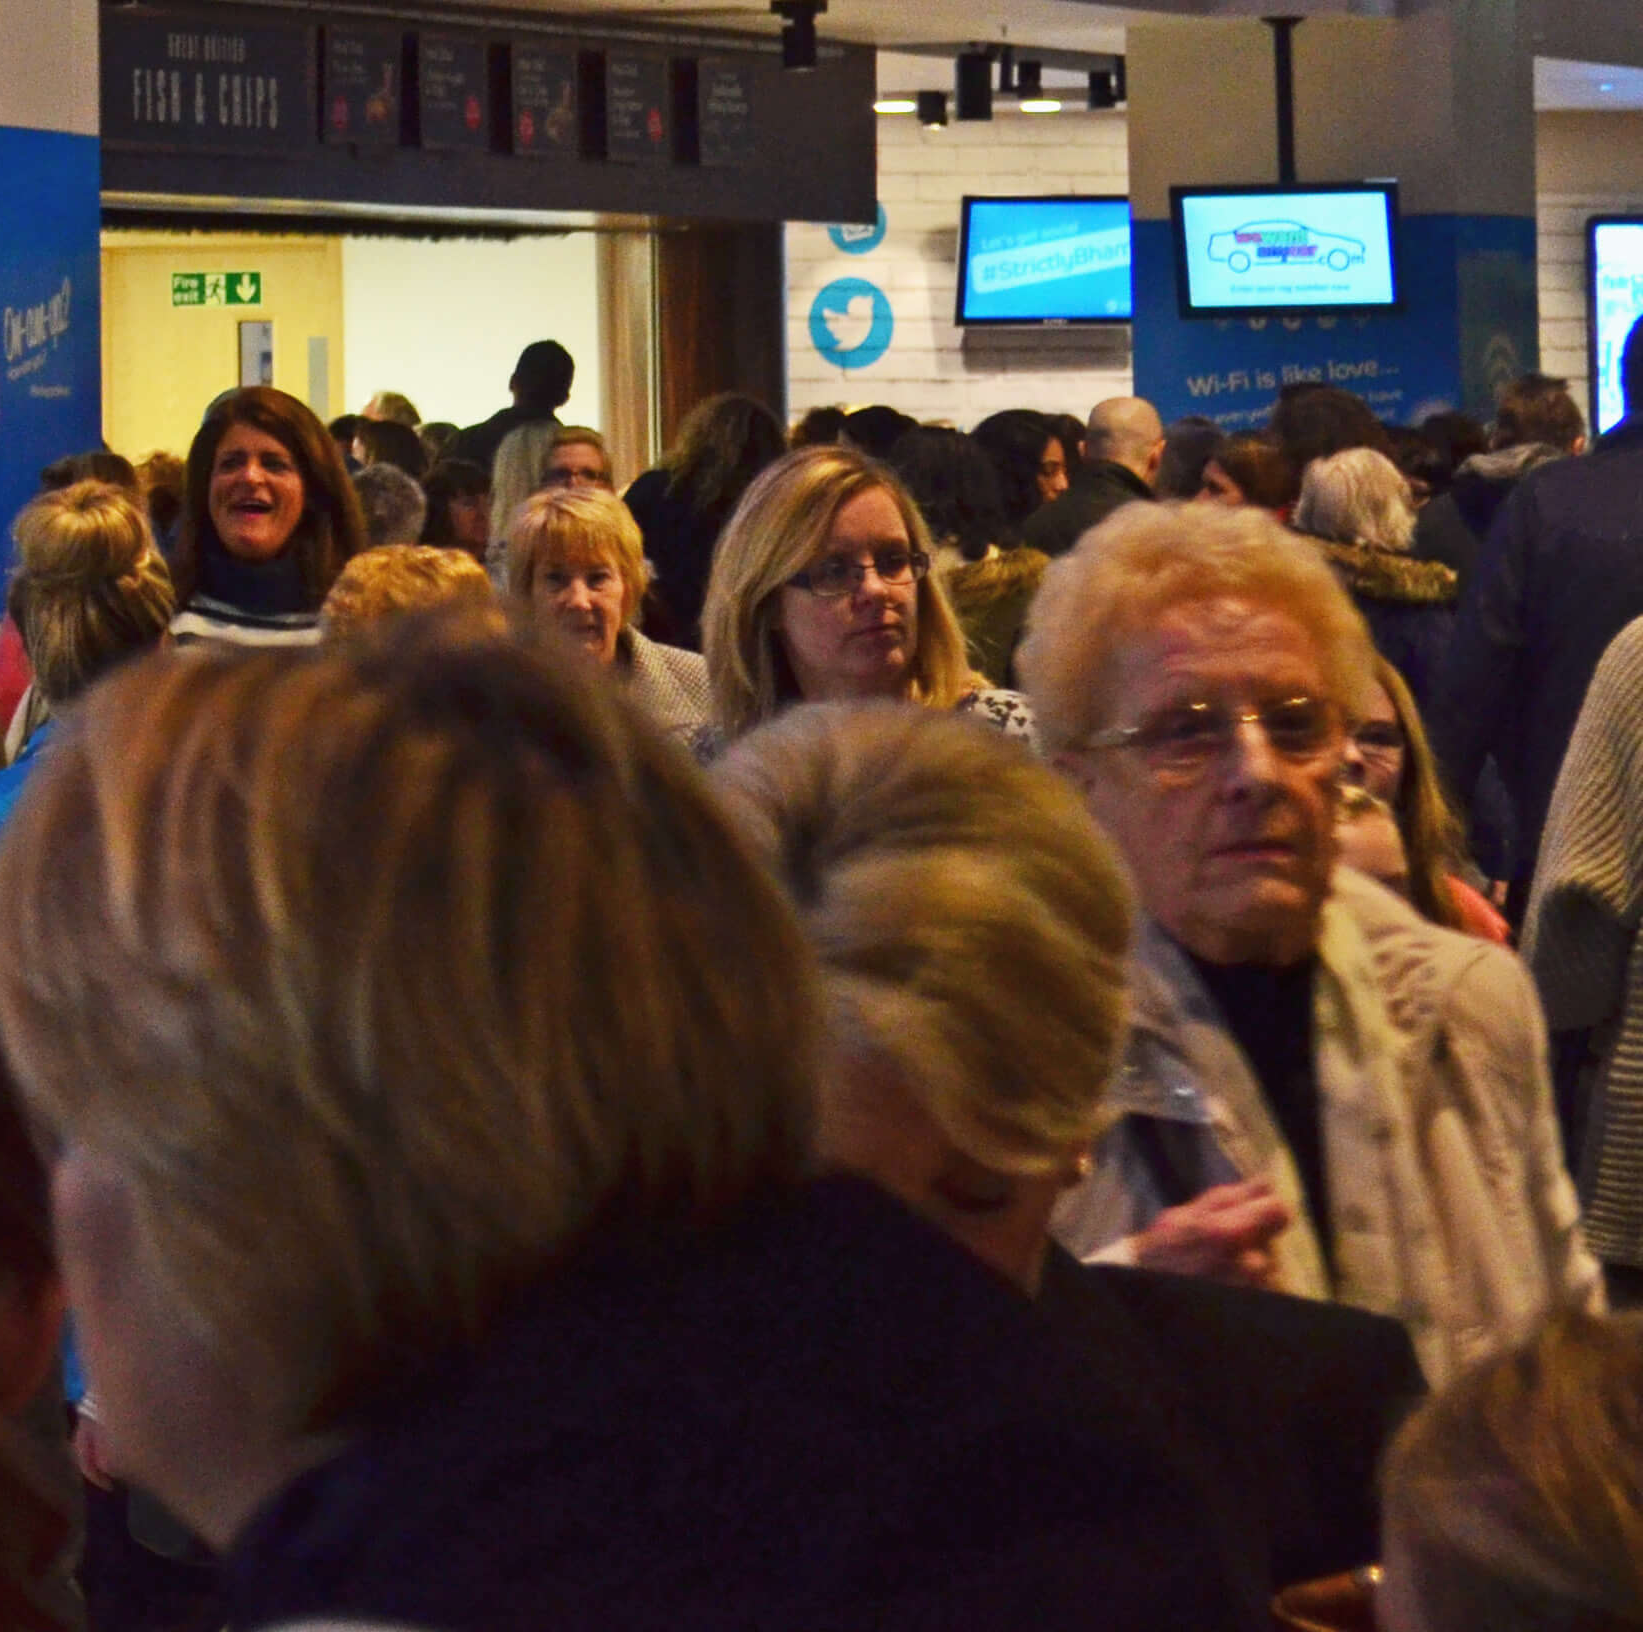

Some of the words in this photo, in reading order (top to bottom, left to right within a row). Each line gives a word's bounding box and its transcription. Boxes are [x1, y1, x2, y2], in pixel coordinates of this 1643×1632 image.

[133, 67, 181, 124] FISH
[218, 73, 278, 129] CHIPS
[1186, 371, 1250, 397] Wi-Fi
[1256, 368, 1276, 389] is
